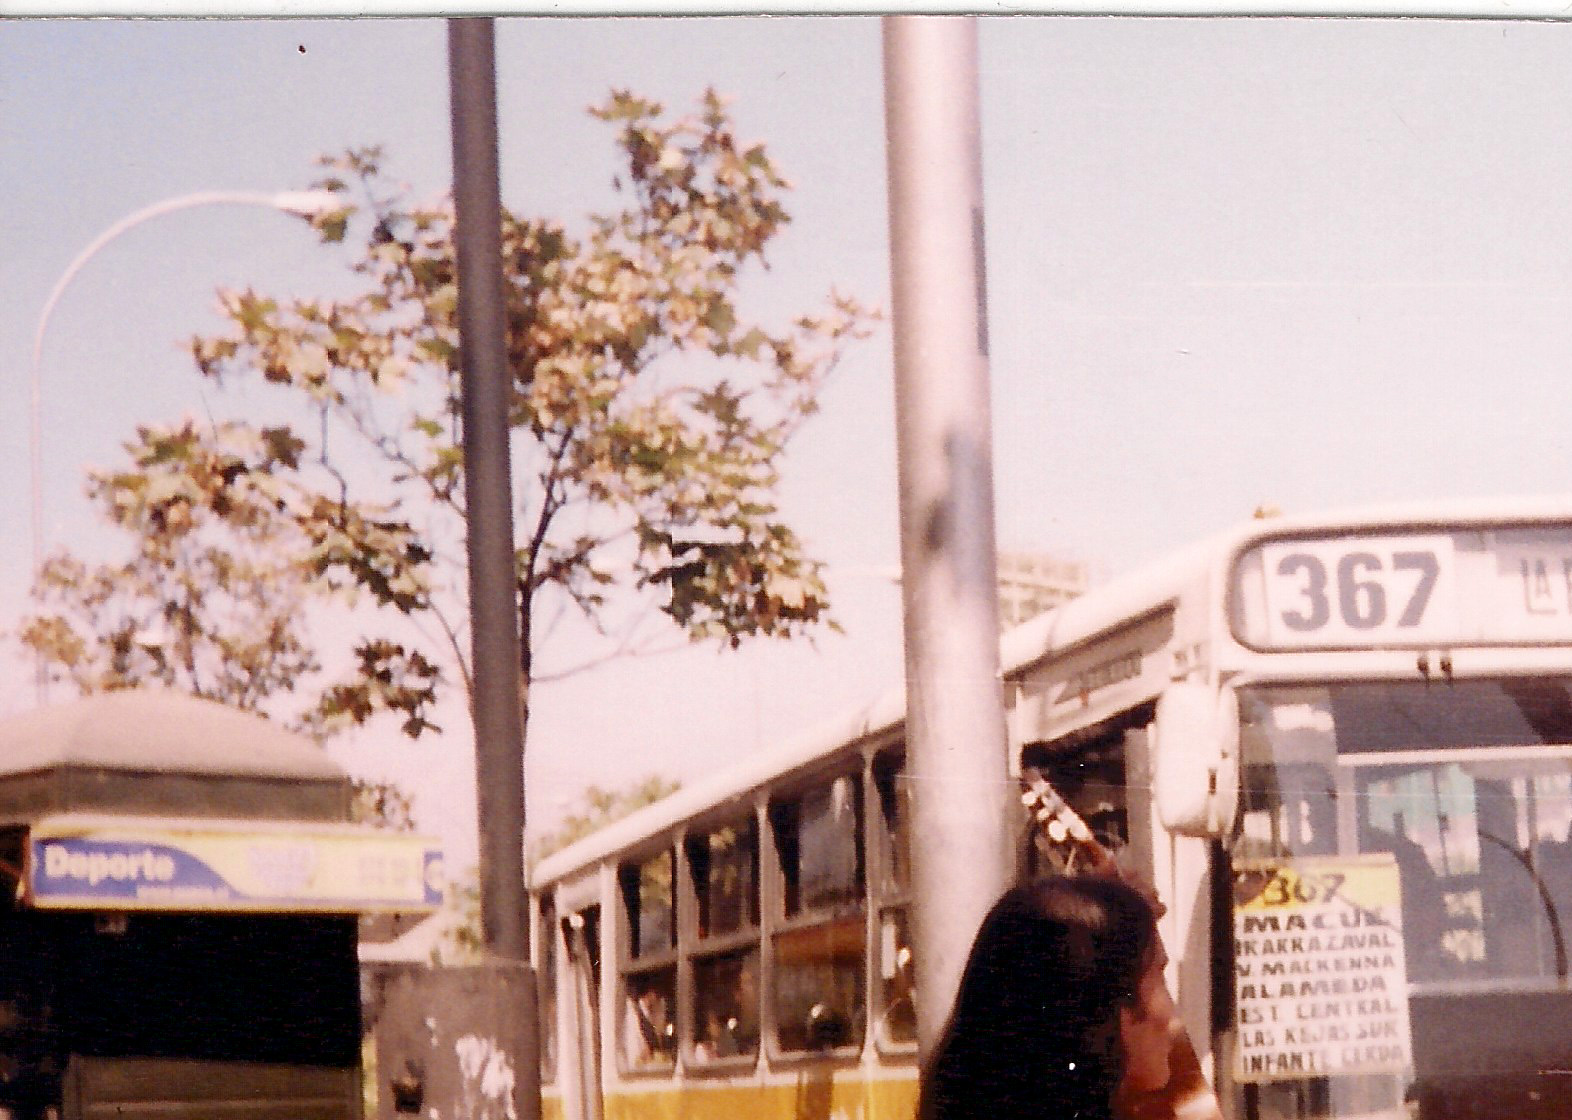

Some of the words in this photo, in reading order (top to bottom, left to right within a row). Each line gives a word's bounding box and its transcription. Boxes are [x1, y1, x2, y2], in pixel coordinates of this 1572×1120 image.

[1276, 549, 1440, 632] 367
[44, 845, 176, 886] Deporte
[1240, 977, 1387, 999] ALAMEDA
